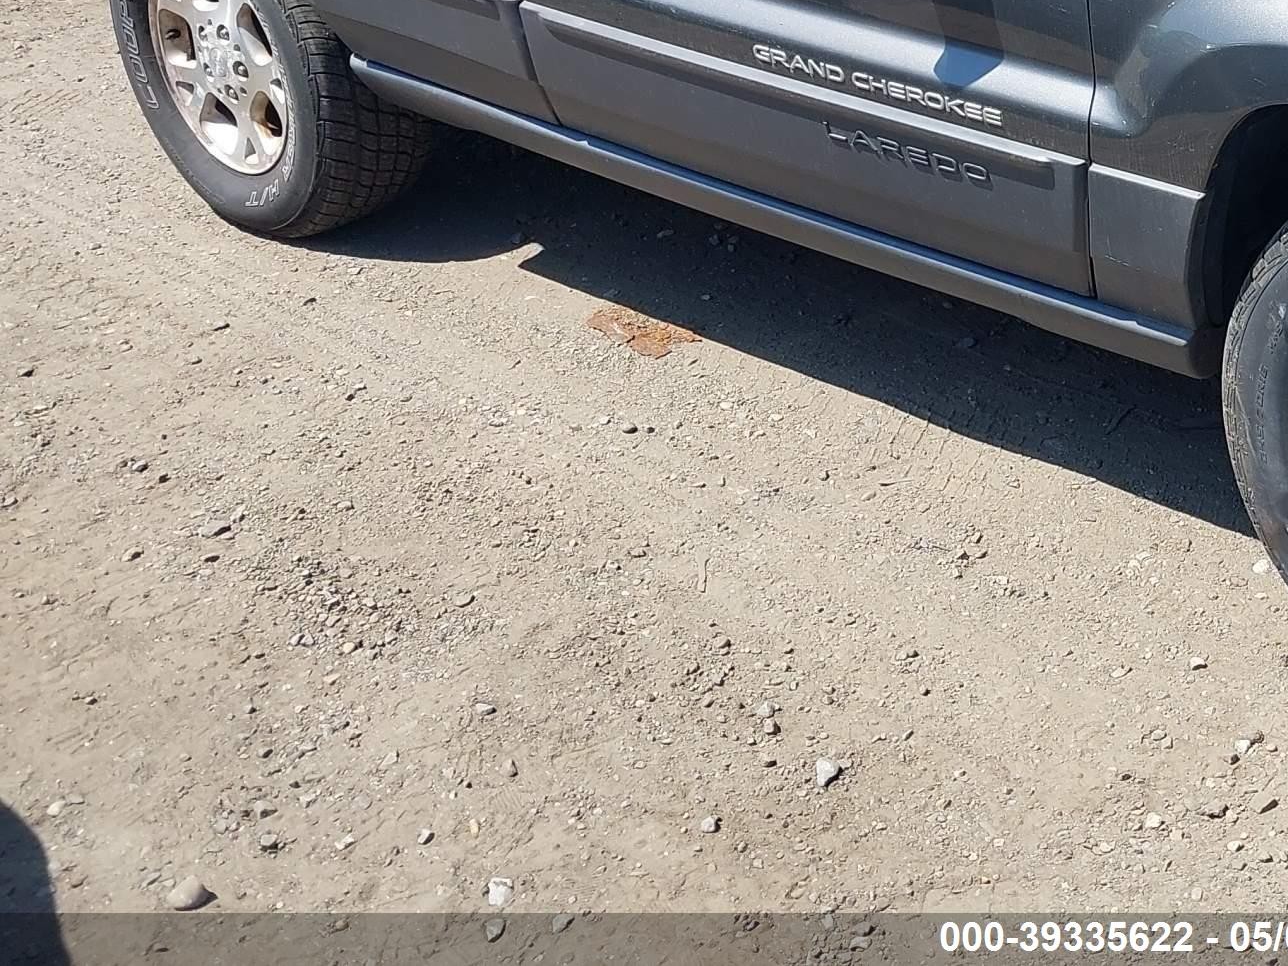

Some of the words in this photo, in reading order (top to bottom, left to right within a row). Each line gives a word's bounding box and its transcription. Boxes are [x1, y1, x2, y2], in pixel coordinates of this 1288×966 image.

[752, 43, 845, 83] GRAND
[851, 72, 1003, 127] CHEROKEE
[820, 120, 992, 187] LAREDO
